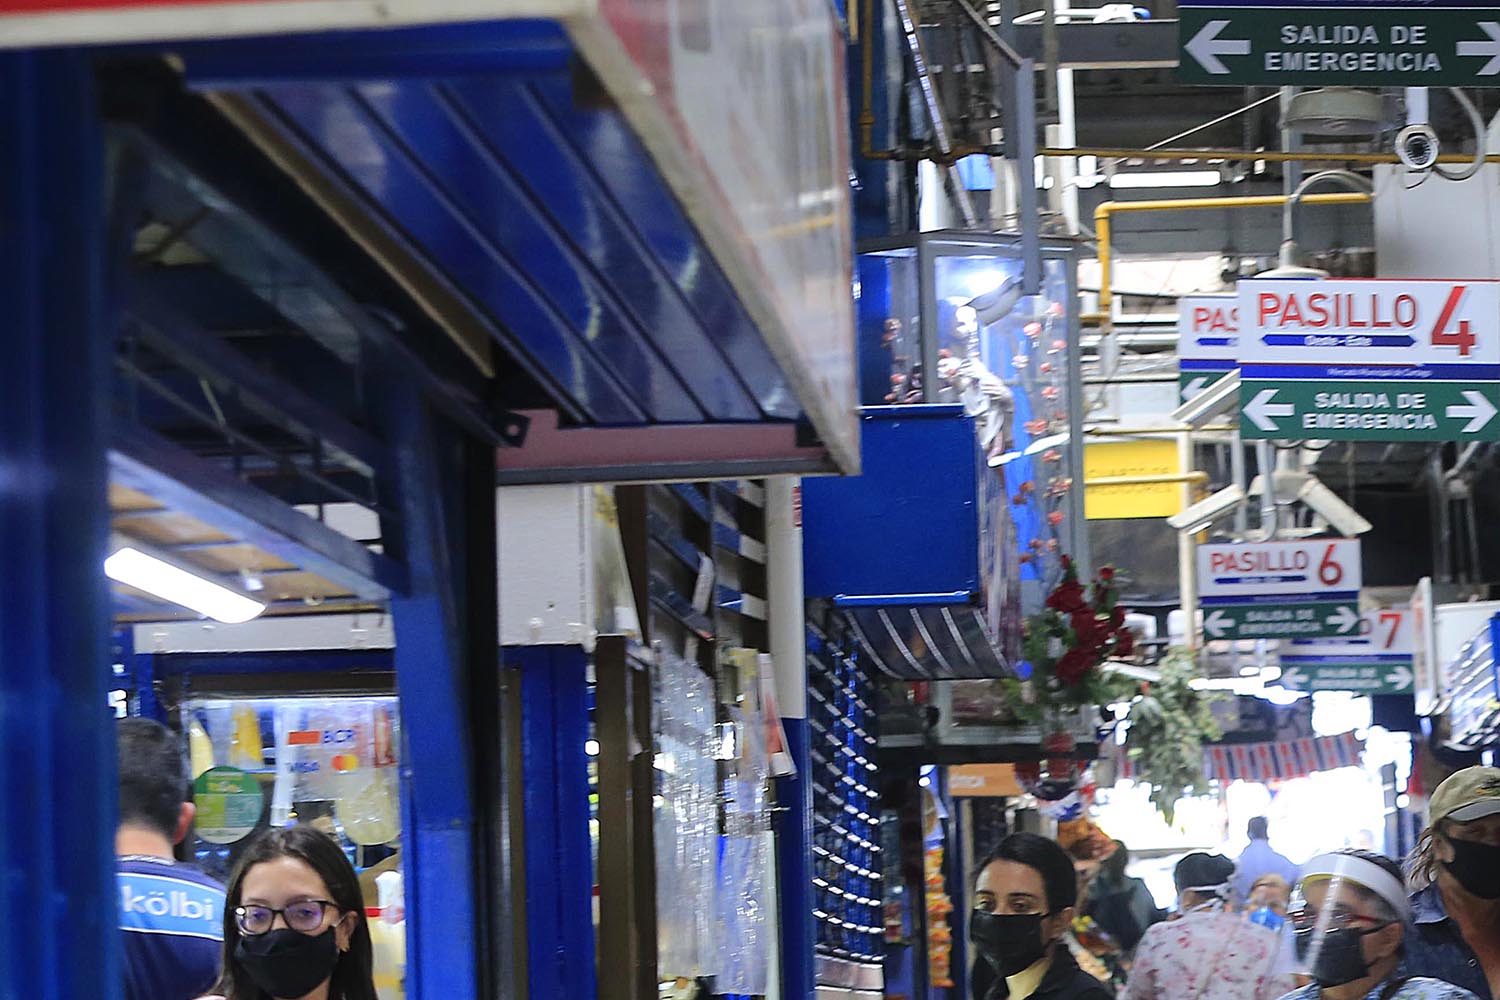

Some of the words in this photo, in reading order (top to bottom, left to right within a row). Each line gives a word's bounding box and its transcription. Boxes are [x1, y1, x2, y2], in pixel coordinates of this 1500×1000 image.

[1280, 25, 1379, 45] SALIDA
[1391, 25, 1427, 45] DE
[1264, 52, 1442, 72] EMERGENCIA
[1257, 292, 1418, 328] PASILLO
[1430, 286, 1476, 356] 4
[1314, 392, 1390, 409] SALIDA
[1396, 393, 1426, 409] DE
[1302, 412, 1438, 430] EMERGENCIA
[1209, 550, 1310, 573] PASILLO
[1317, 543, 1344, 587] 6
[1379, 613, 1403, 649] 7
[121, 884, 214, 921] kölbi
